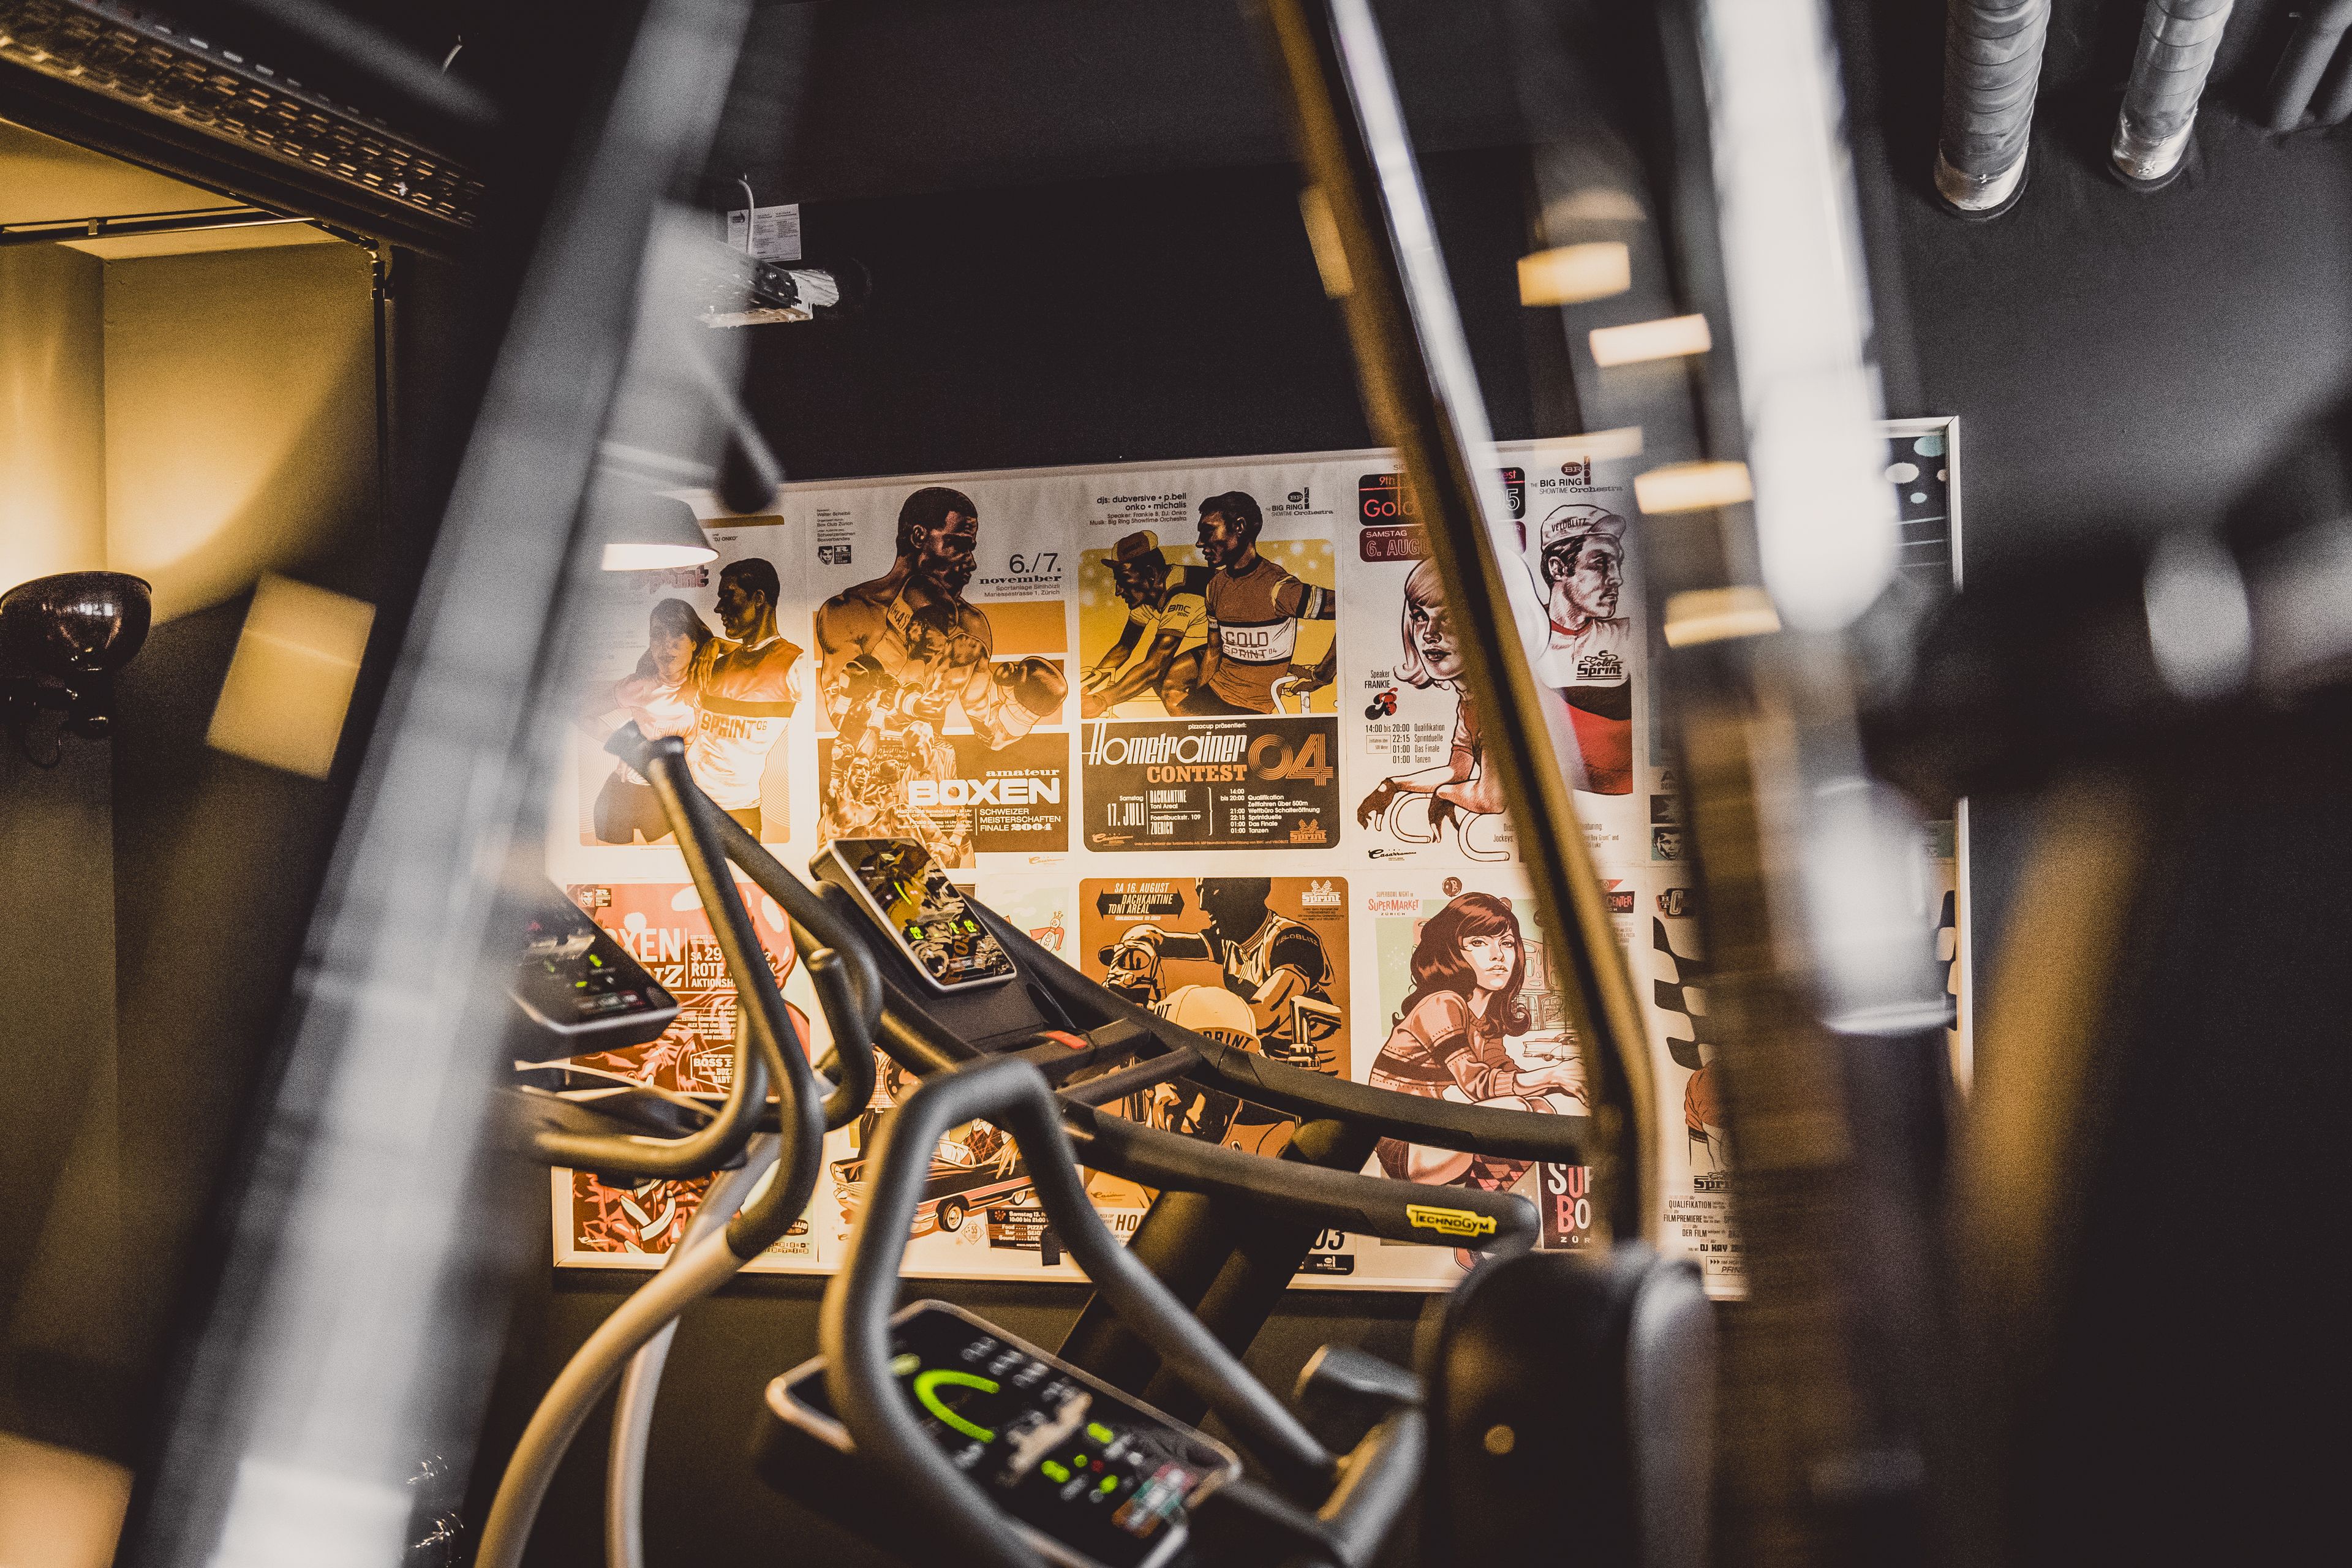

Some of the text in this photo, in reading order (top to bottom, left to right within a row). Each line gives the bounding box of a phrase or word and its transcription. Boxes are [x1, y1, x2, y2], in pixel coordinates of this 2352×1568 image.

[1379, 477, 1395, 485] 9th
[1112, 494, 1156, 503] dubversive
[1551, 518, 1587, 533] VELOBLITZ
[1366, 540, 1382, 556] 6.
[979, 575, 1061, 584] november
[1167, 603, 1191, 614] BMC
[1226, 631, 1269, 647] GOLD
[1223, 644, 1267, 659] SPRINT
[1370, 669, 1390, 679] Speaker
[1577, 663, 1623, 677] Sprint
[1364, 680, 1390, 688] FRANKIE
[701, 714, 756, 739] SPRINT
[1365, 724, 1382, 733] 14:00
[1392, 723, 1409, 732] 20:00
[1414, 723, 1445, 732] Qualifikation
[1392, 733, 1443, 743] 22:15 Sprintduelle
[1082, 723, 1333, 786] Hometrainer 04
[1392, 755, 1431, 764] 01:00 Tanzen
[1147, 764, 1247, 783] CONTEST
[908, 778, 1060, 805] BOXEN
[1150, 790, 1187, 803] DACHKANTINE
[1107, 802, 1145, 826] 17. JULI
[1150, 821, 1173, 835] ZUERICH
[1290, 831, 1327, 841] Sprint
[1114, 882, 1170, 892] SA 16. AUGUST
[1121, 894, 1174, 905] DACHKANTINE
[1302, 894, 1341, 903] Sprint
[1108, 904, 1150, 914] TONI AREAL
[690, 952, 703, 961] SA
[692, 962, 725, 977] ROTE
[693, 1058, 723, 1067] BOSS
[1668, 1200, 1711, 1209] QUALIFIKATION
[1664, 1214, 1703, 1223] FILMPREMIERE
